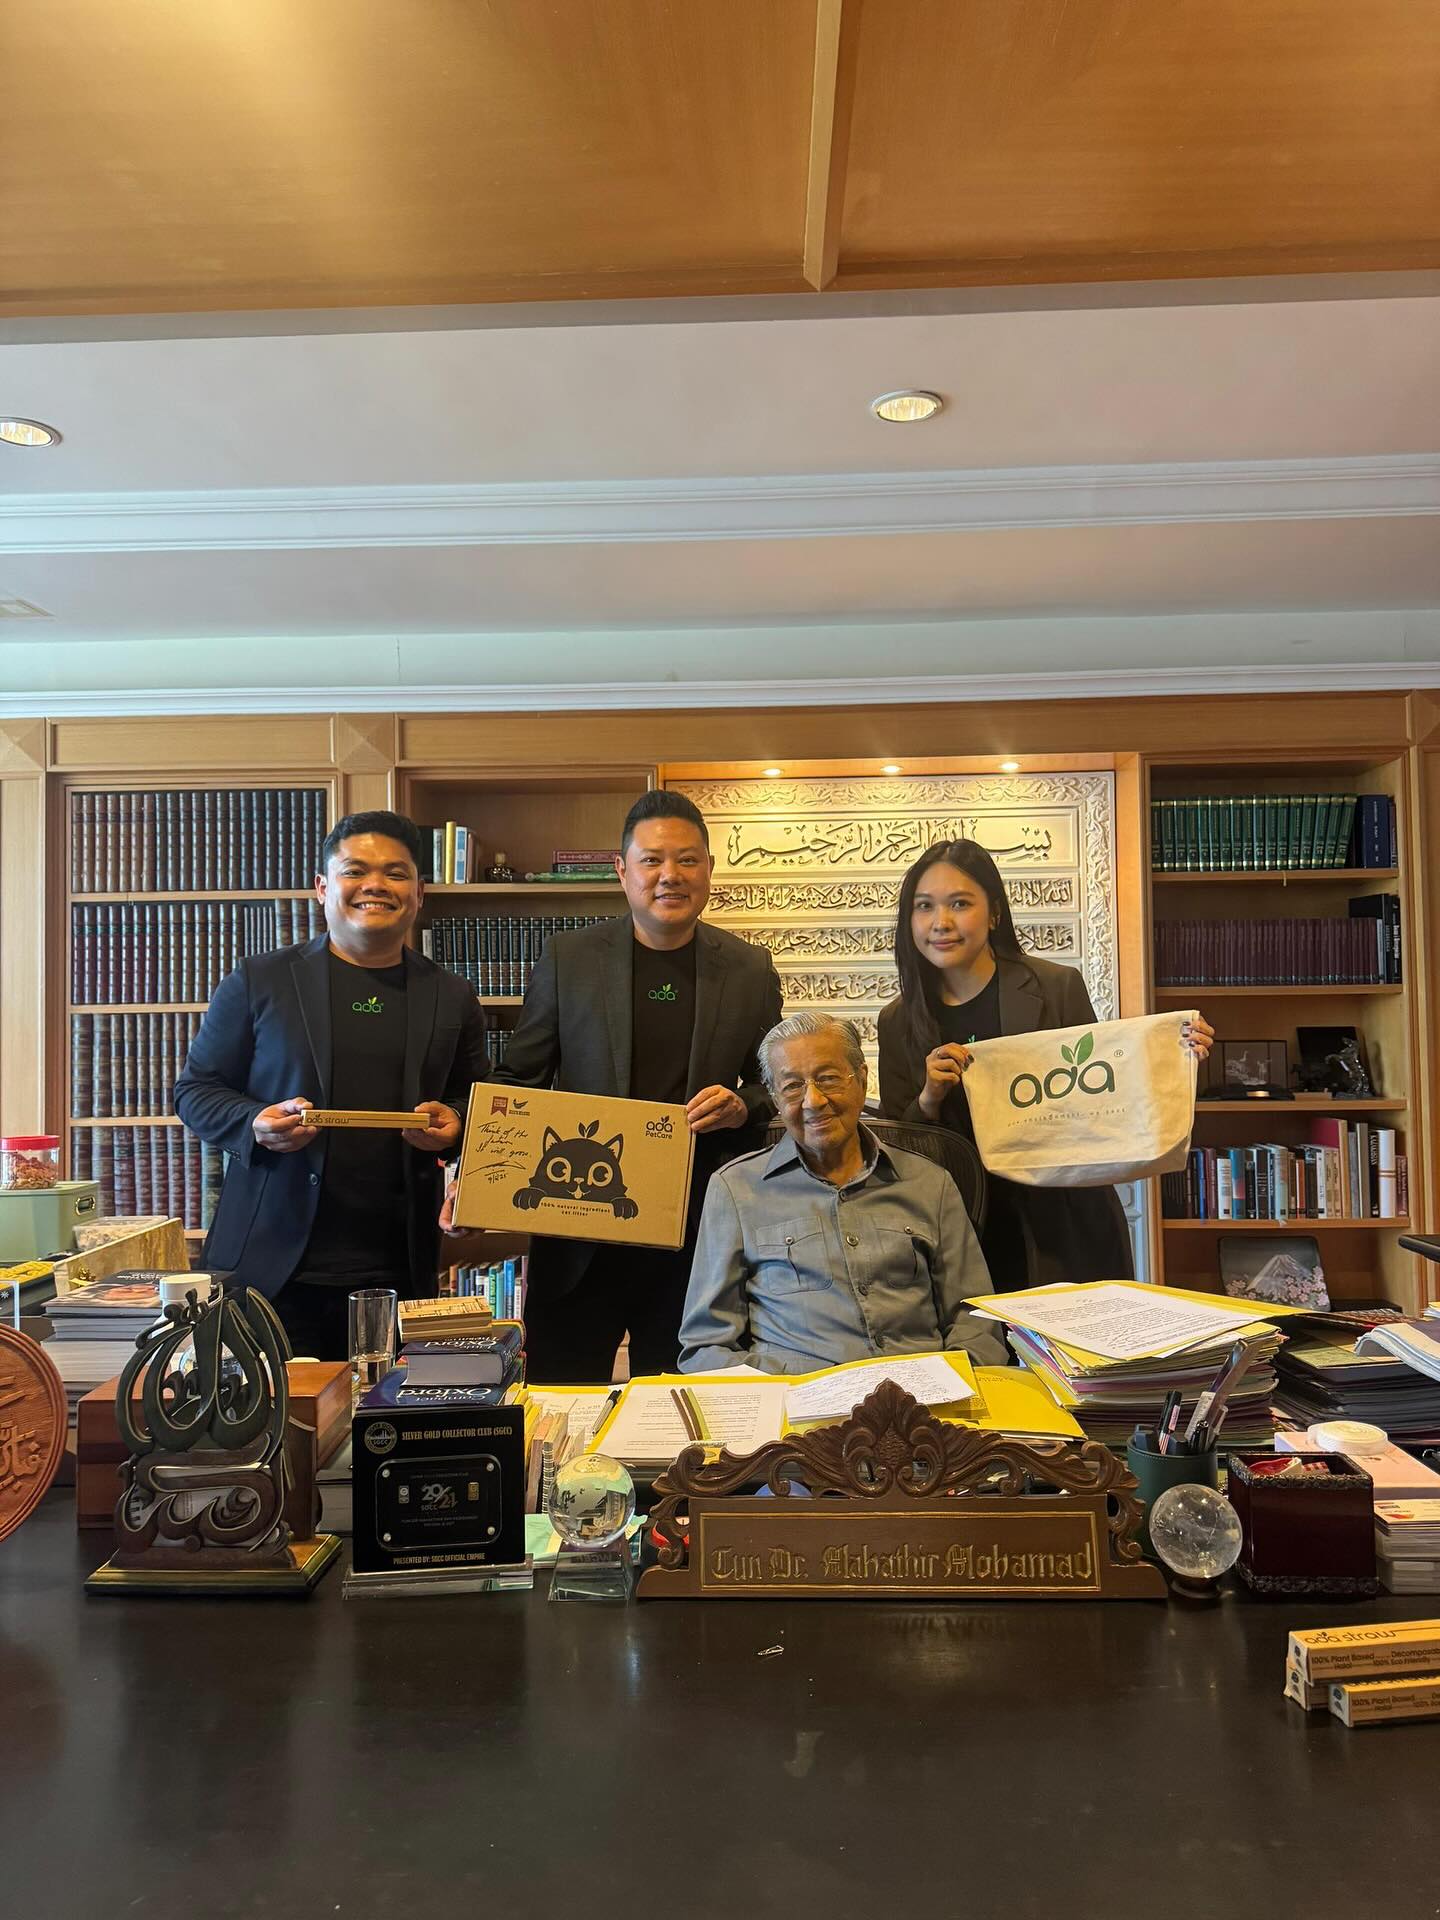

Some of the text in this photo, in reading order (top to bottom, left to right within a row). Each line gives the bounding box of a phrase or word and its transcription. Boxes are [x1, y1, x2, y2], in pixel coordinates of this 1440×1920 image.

[1009, 1058, 1116, 1108] ada
[478, 1121, 501, 1134] Think
[646, 1118, 673, 1133] ada
[645, 1130, 673, 1139] PetCare
[425, 1339, 497, 1348] Oxford
[396, 1387, 492, 1399] Oxford
[416, 1394, 486, 1402] Compact
[402, 1426, 513, 1441] SILVER GOLD COLLECTOR CLUB (SGCC)
[393, 1556, 421, 1565] PRESENTED
[445, 1554, 466, 1562] OFFICIAL
[711, 1546, 762, 1580] Tun
[821, 1543, 941, 1580] Mahathir
[943, 1541, 1094, 1580] Mohamad
[1342, 1631, 1397, 1642] straw
[1311, 1655, 1330, 1664] 100%
[1331, 1654, 1350, 1663] Plant
[1351, 1652, 1375, 1661] Based
[1404, 1656, 1430, 1664] Friendly
[1371, 1696, 1392, 1705] Plant
